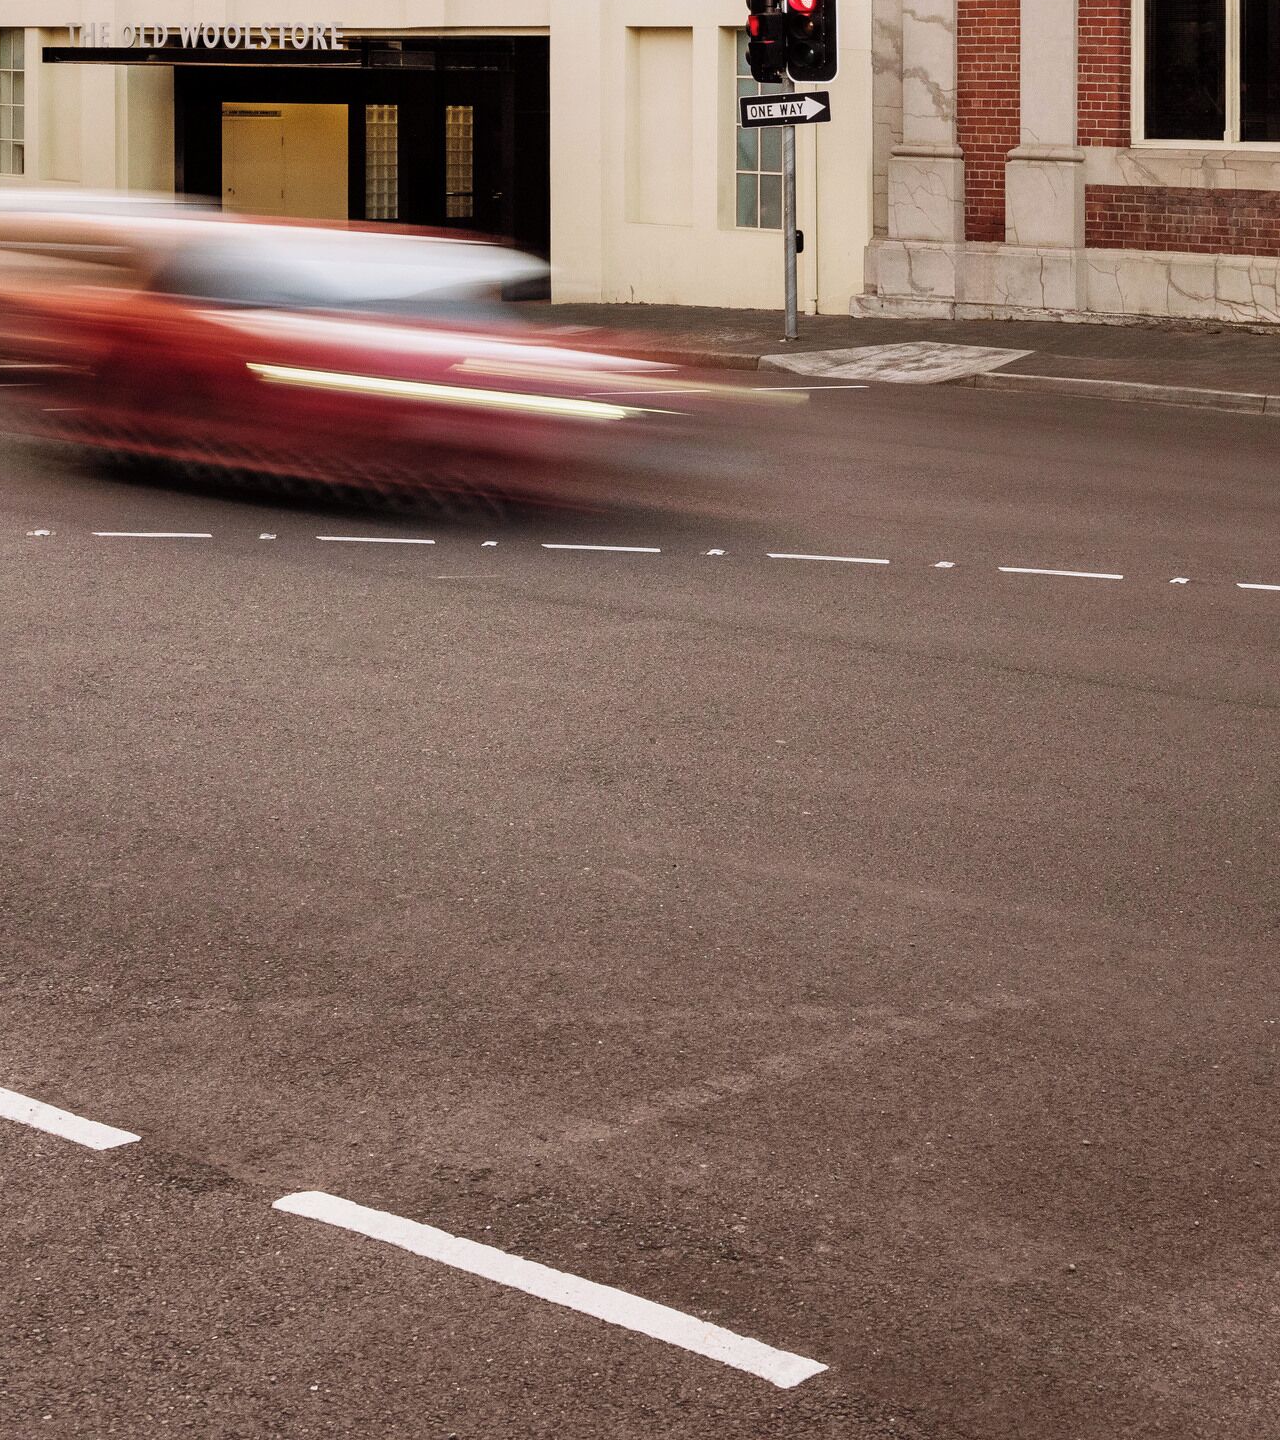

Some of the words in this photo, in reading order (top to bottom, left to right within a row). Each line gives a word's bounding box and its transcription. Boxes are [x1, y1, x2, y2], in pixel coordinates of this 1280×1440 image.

[66, 22, 110, 49] THE
[122, 23, 168, 49] OLD
[179, 21, 344, 51] WOOLSTORE
[750, 105, 773, 118] ONE
[780, 103, 804, 116] WAY
